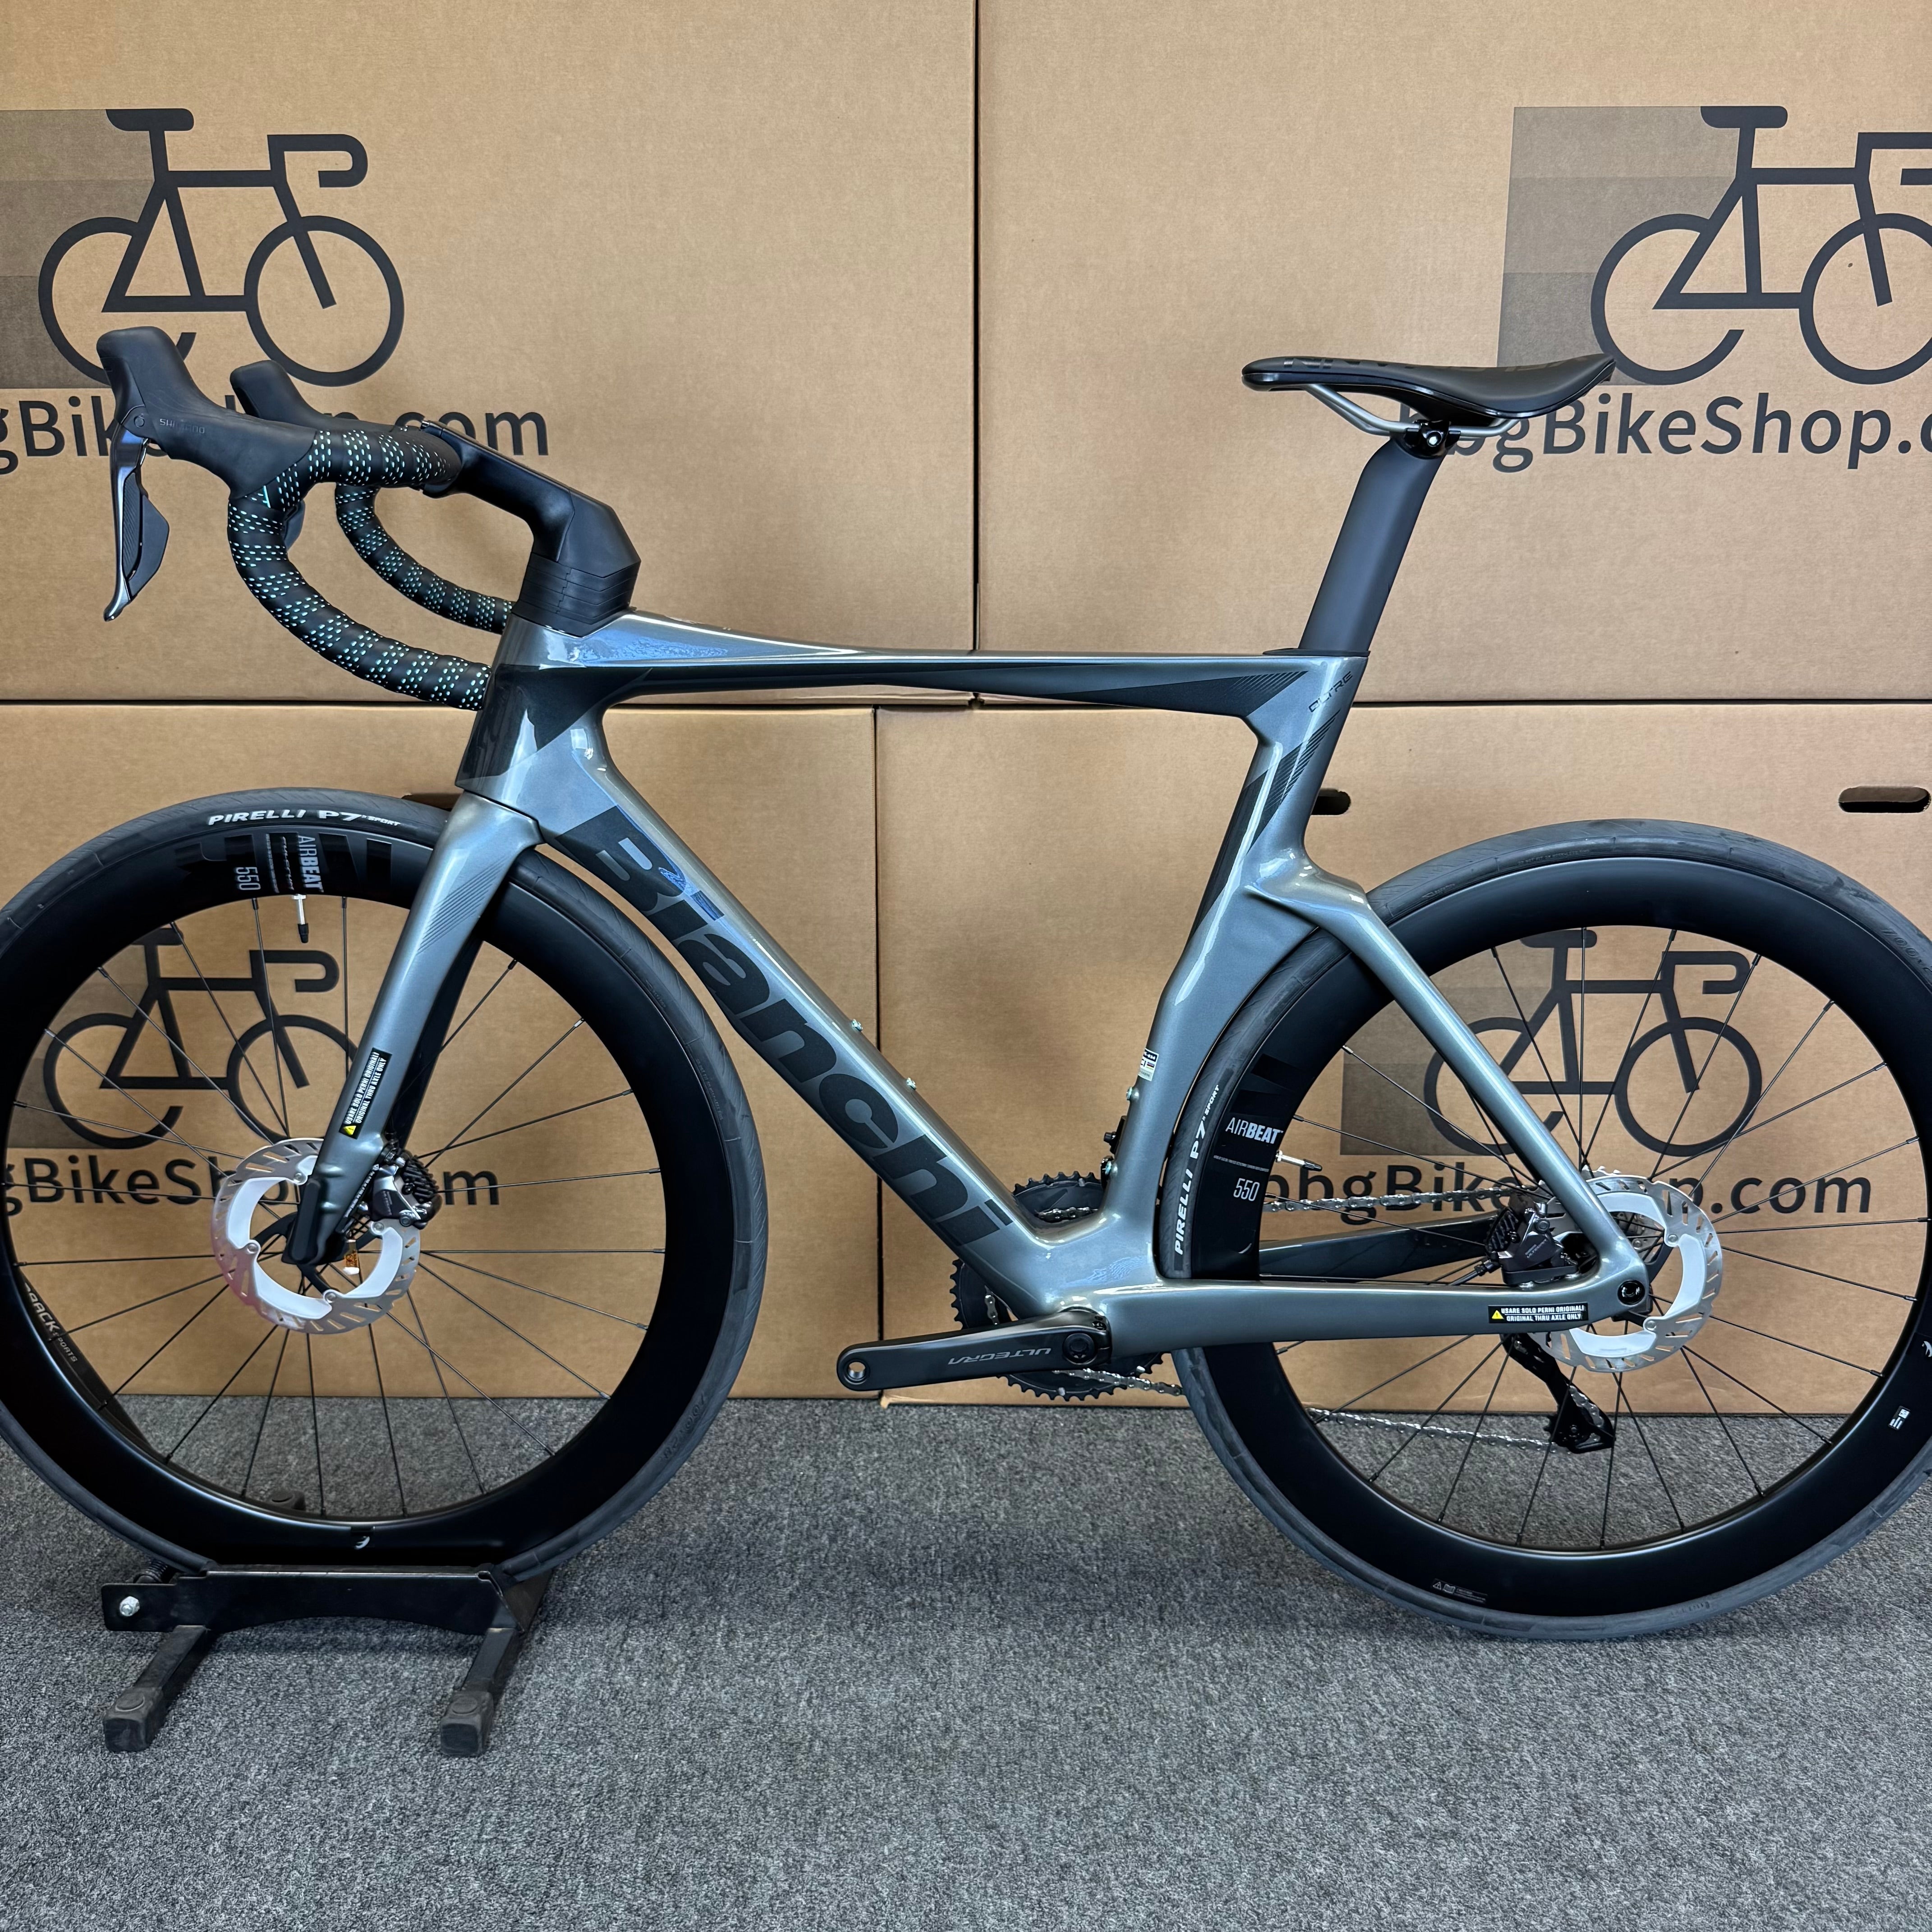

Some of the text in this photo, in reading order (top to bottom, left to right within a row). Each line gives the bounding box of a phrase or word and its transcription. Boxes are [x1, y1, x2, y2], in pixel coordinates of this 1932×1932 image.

[159, 418, 205, 434] SHIANO
[1399, 392, 1932, 473] gBikeShop.
[1309, 671, 1353, 713] OLTRE
[208, 809, 307, 826] PIRELLI
[317, 810, 362, 821] P7
[235, 866, 261, 891] 550
[298, 835, 324, 889] AIRBEAT
[555, 805, 1013, 1247] Bianchi
[344, 1051, 380, 1124] USARE SOLO PERNI ORIGINALI
[355, 1058, 387, 1123] ORIGINAL THRU AXLE ONLY
[1225, 1117, 1283, 1144] AIRBEAT
[1174, 1085, 1219, 1255] PIRELLI P7 SPORT
[1233, 1178, 1260, 1202] 550
[948, 1348, 1052, 1365] ULTEGRA
